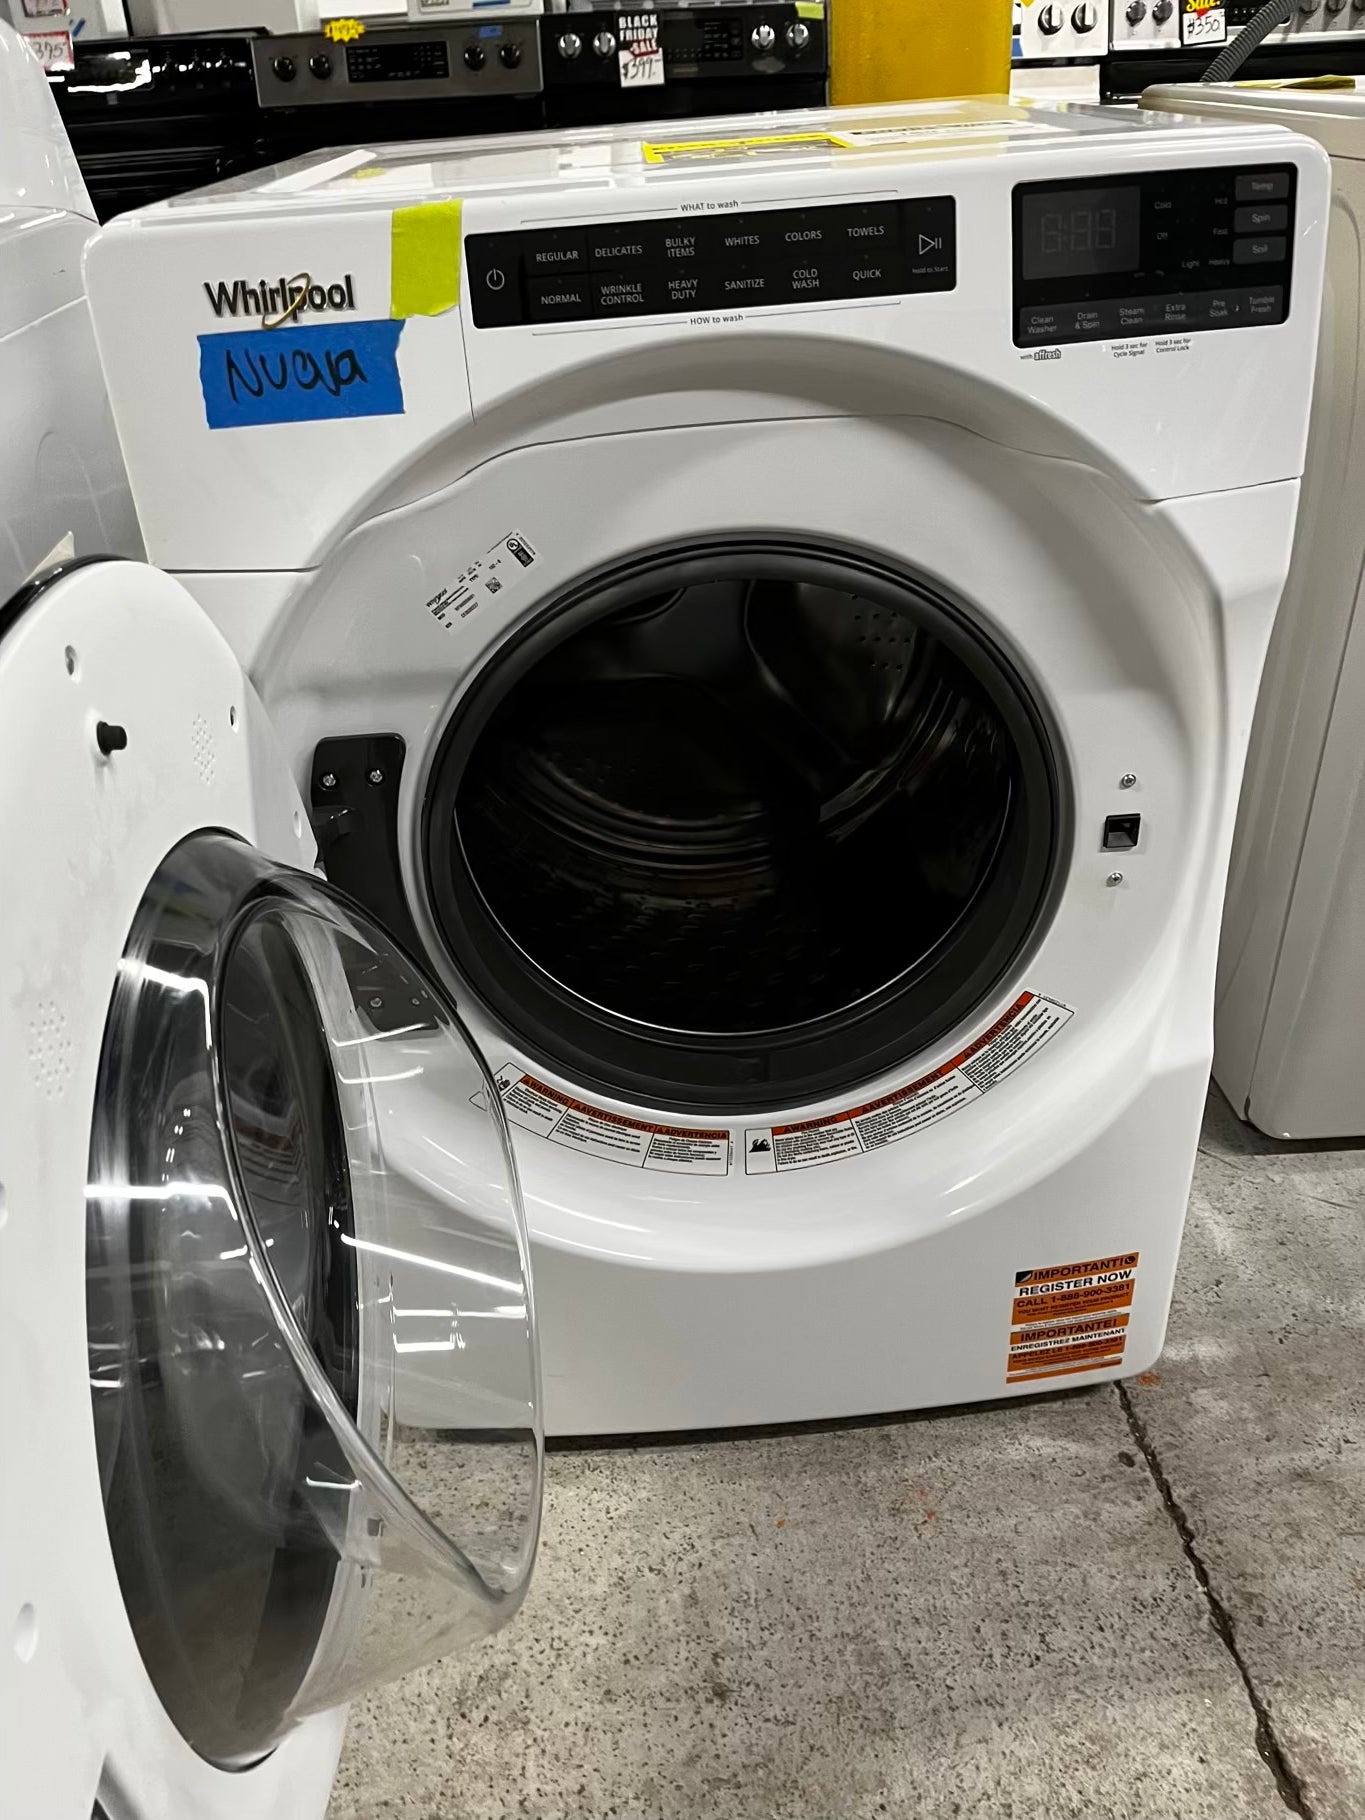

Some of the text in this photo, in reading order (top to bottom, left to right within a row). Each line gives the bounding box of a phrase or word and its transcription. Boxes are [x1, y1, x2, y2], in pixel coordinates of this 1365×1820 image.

[619, 14, 657, 28] BLACK
[620, 28, 658, 41] FRIDAY
[632, 39, 658, 54] SALE
[681, 203, 704, 211] WHAT
[717, 200, 738, 208] wash
[1252, 213, 1271, 223] Spin
[785, 230, 823, 242] COLORS
[847, 226, 885, 237] TOWELS
[665, 236, 696, 248] BULKY
[724, 235, 760, 247] WHITES
[535, 250, 579, 263] REGULAR
[594, 245, 643, 258] DELICATES
[667, 247, 696, 258] ITEMS
[793, 268, 818, 280] COLD
[852, 269, 882, 281] QUICK
[600, 283, 642, 295] WRINKLE
[668, 279, 699, 290] HEAVY
[724, 278, 765, 290] SANITIZE
[792, 279, 820, 289] WASH
[204, 273, 355, 324] Whirlpool
[540, 293, 582, 305] NORMAL
[600, 293, 645, 305] CONTROL
[671, 289, 697, 300] DUTY
[1120, 307, 1145, 317] Steam
[1165, 303, 1186, 312] Extra
[690, 316, 710, 325] HOW
[723, 314, 743, 322] wash
[1031, 315, 1054, 325] Clean
[1077, 311, 1098, 321] Drain
[1121, 315, 1144, 325] Clean
[1027, 324, 1057, 335] Washer
[1083, 320, 1100, 330] Spin
[1033, 349, 1061, 360] affresh
[970, 1003, 1023, 1056] ADVERTENCIA
[528, 1080, 569, 1105] WARNING
[581, 1105, 653, 1131] AVERTISSEMENT
[791, 1117, 837, 1131] WARNING
[664, 1127, 728, 1139] ADVERTENCIA
[1034, 1257, 1123, 1280] IMPORTANT!
[1019, 1270, 1132, 1296] REGISTER NOW
[1017, 1298, 1047, 1308] CALL
[1020, 1319, 1117, 1341] IMPORTANTE!
[1011, 1329, 1124, 1351] ENREGISTREZ MAINTENANT
